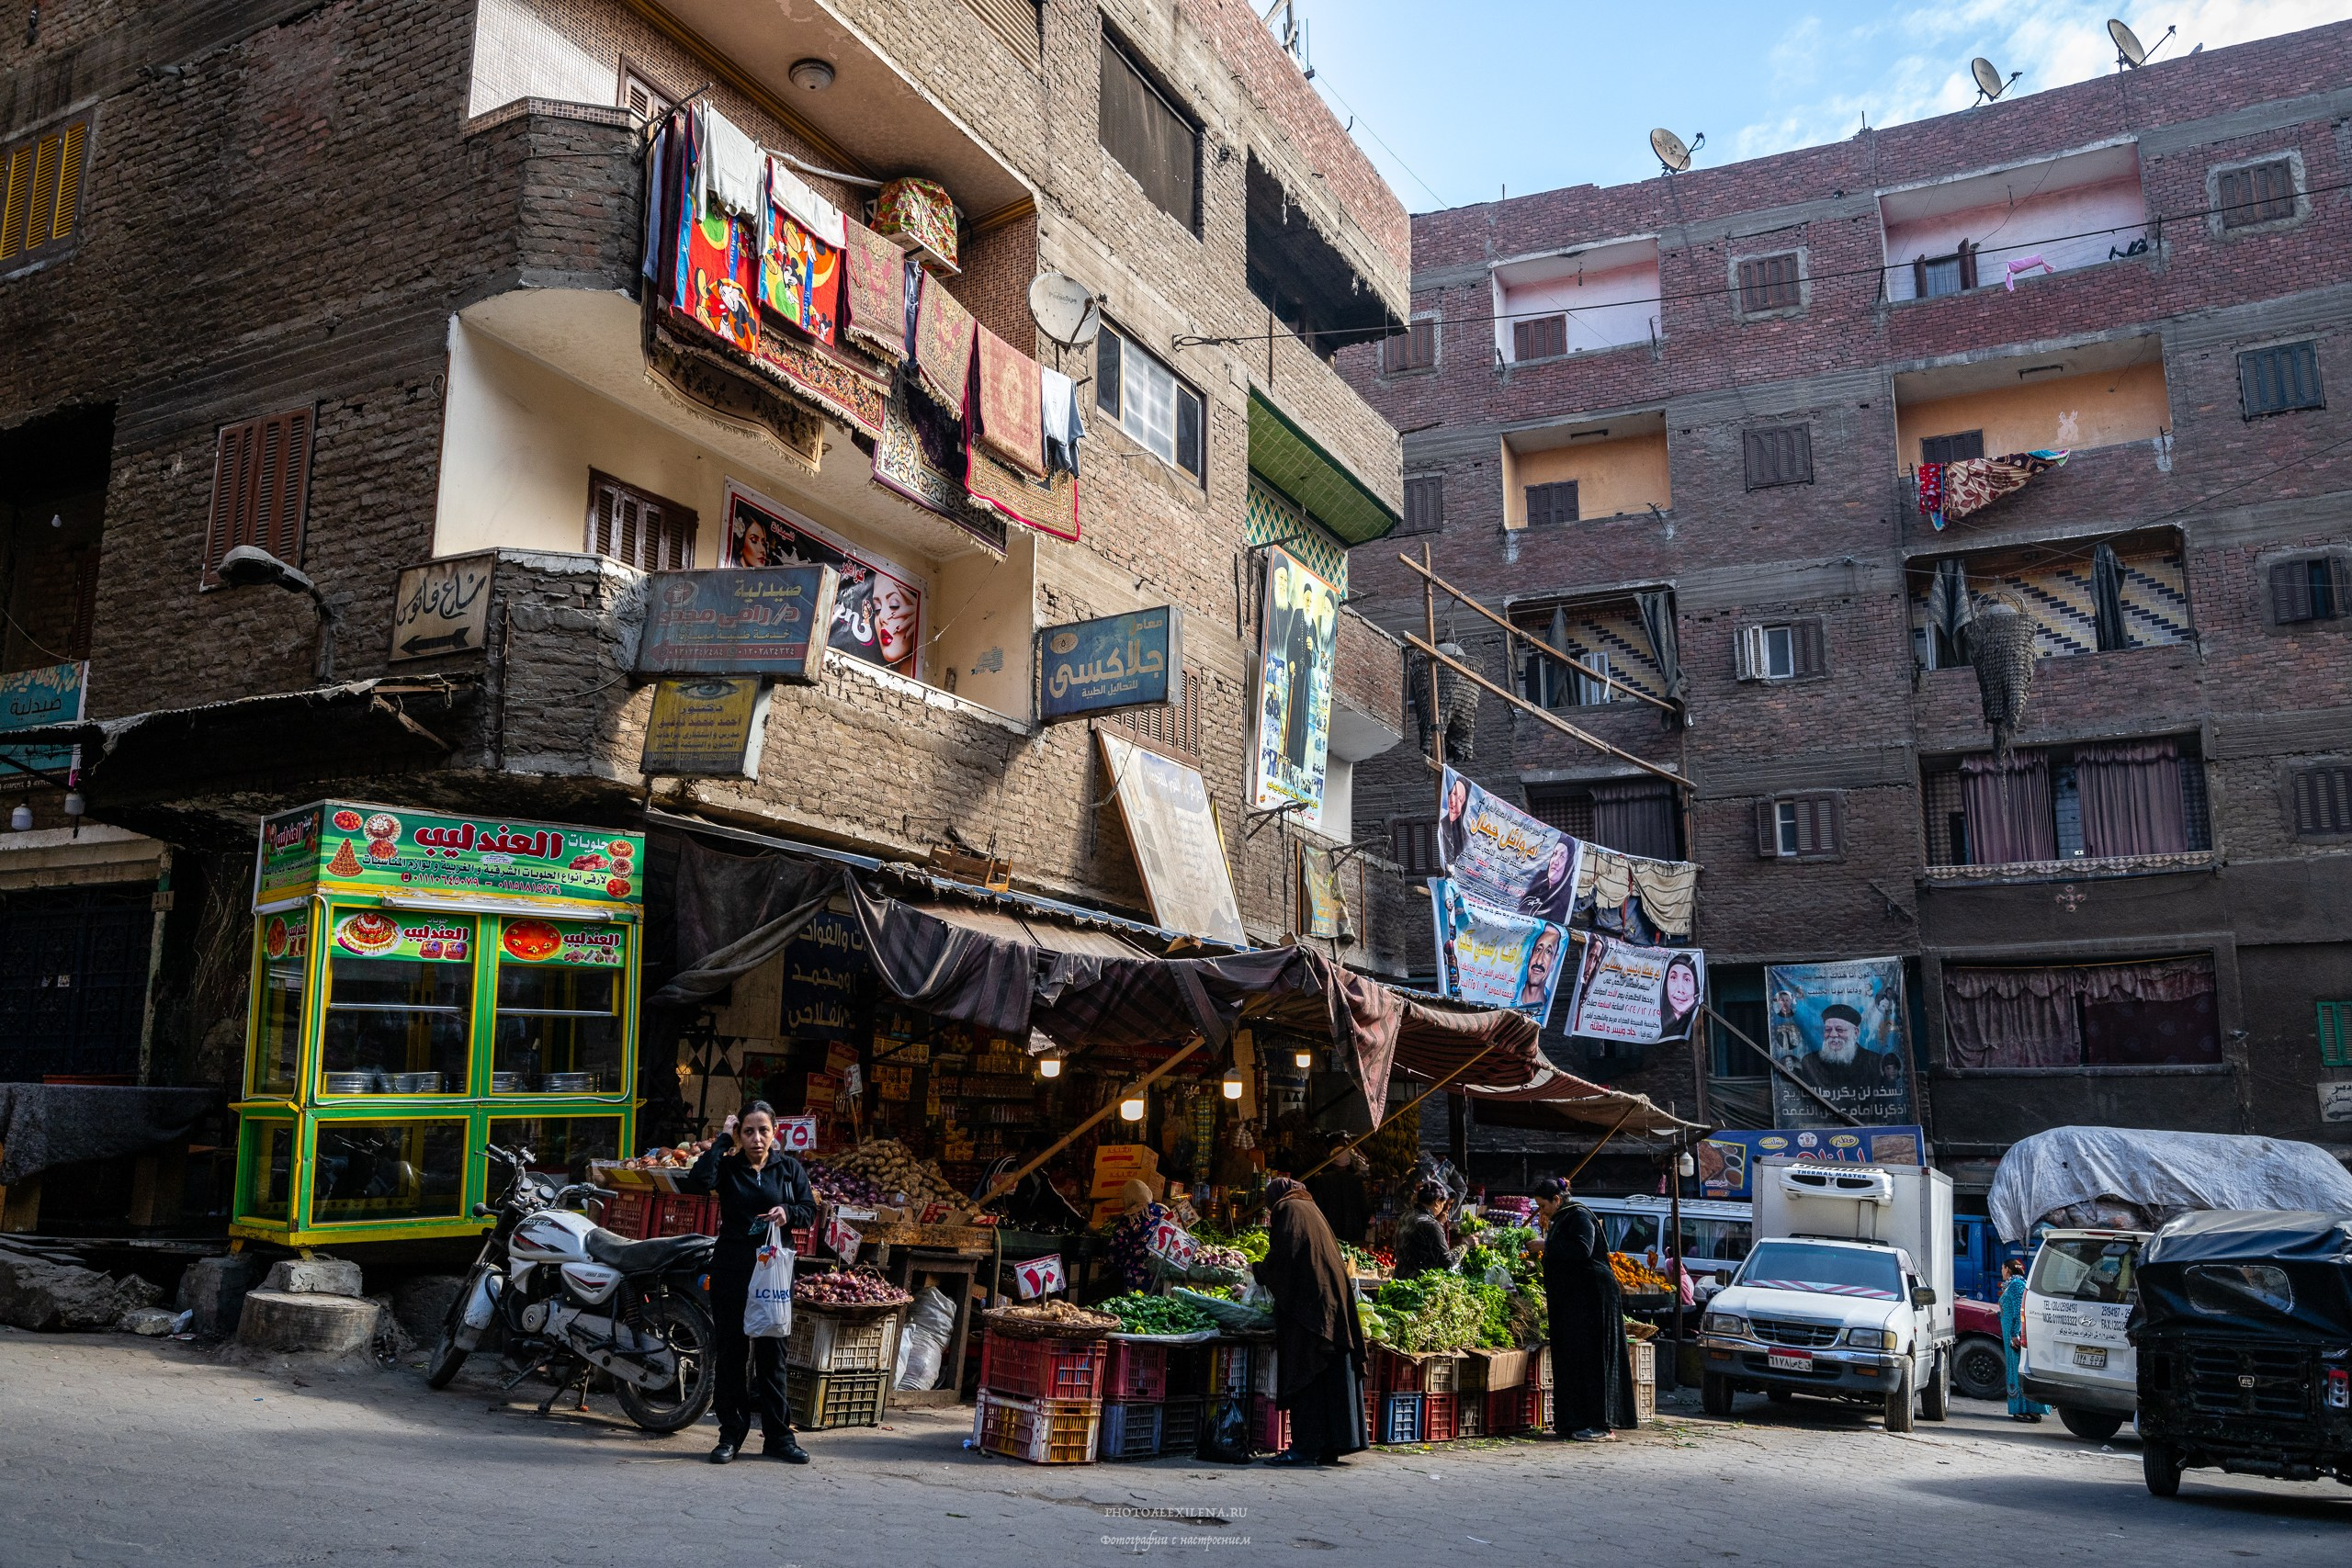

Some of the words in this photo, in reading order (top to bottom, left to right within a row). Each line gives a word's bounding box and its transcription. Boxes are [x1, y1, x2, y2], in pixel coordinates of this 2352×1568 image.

[734, 579, 802, 604] صيدلية
[1128, 617, 1162, 636] معامل
[717, 629, 751, 642] طبية
[753, 628, 790, 641] خدمة
[1081, 684, 1106, 699] الطبية
[1107, 680, 1138, 696] للتحاليل
[10, 695, 62, 721] صيدلية
[680, 704, 724, 715] دكتور
[1470, 812, 1499, 844] جمال
[414, 822, 566, 860] العندليب
[568, 834, 609, 853] حلويات
[362, 854, 407, 868] المناسبات
[441, 862, 474, 874] الغربية
[483, 863, 520, 877] الشرقية
[522, 867, 560, 880] الحلويات
[560, 872, 582, 884] أنواع
[403, 924, 469, 943] العندليب
[563, 931, 621, 949] العندليب
[1858, 1085, 1871, 1100] لن
[1836, 1136, 1854, 1146] فطير
[755, 1289, 771, 1299] LC
